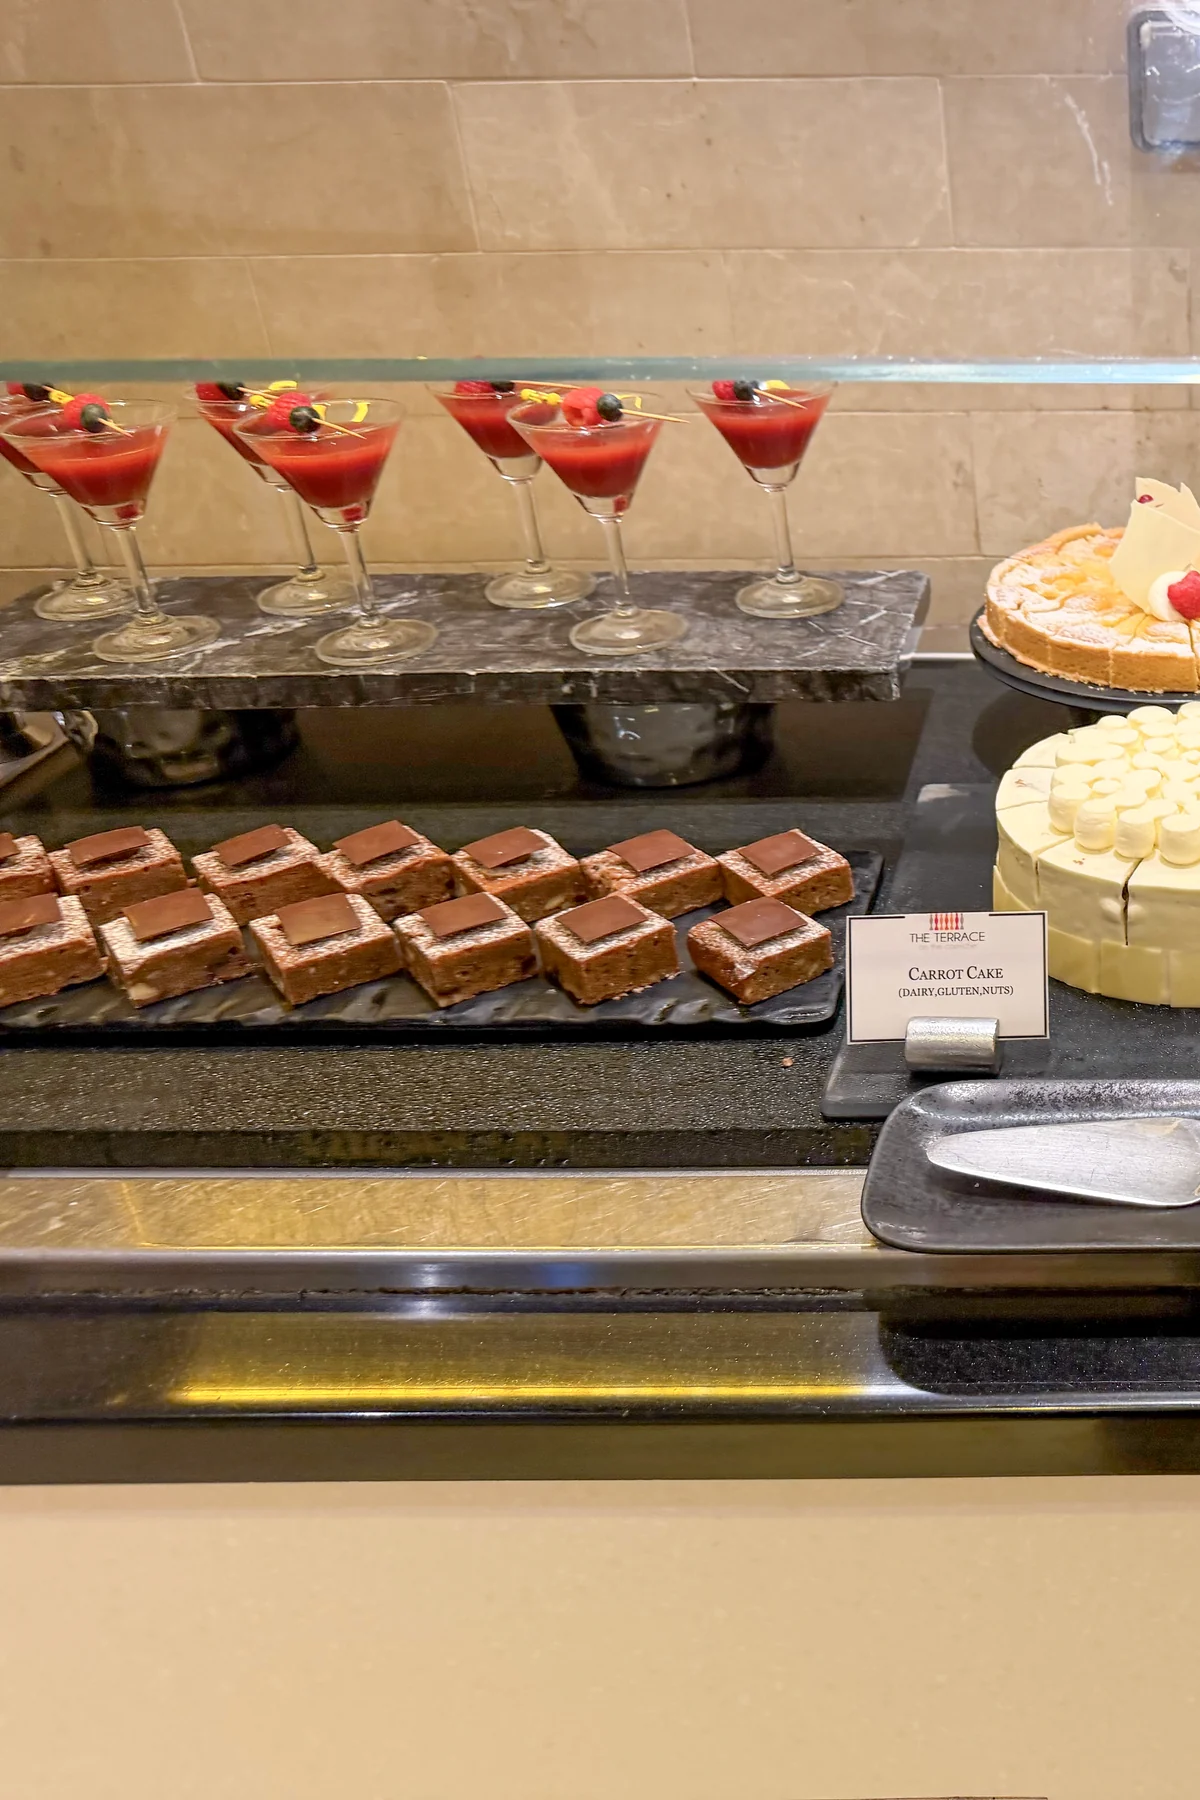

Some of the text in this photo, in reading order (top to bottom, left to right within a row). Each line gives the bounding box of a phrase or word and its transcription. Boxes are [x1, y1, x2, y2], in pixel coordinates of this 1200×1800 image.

[909, 931, 986, 943] THE TERRACE
[908, 965, 1004, 981] CARROT CAKE
[898, 984, 1014, 999] (DAIRY,GLUTEN,NUTS)
